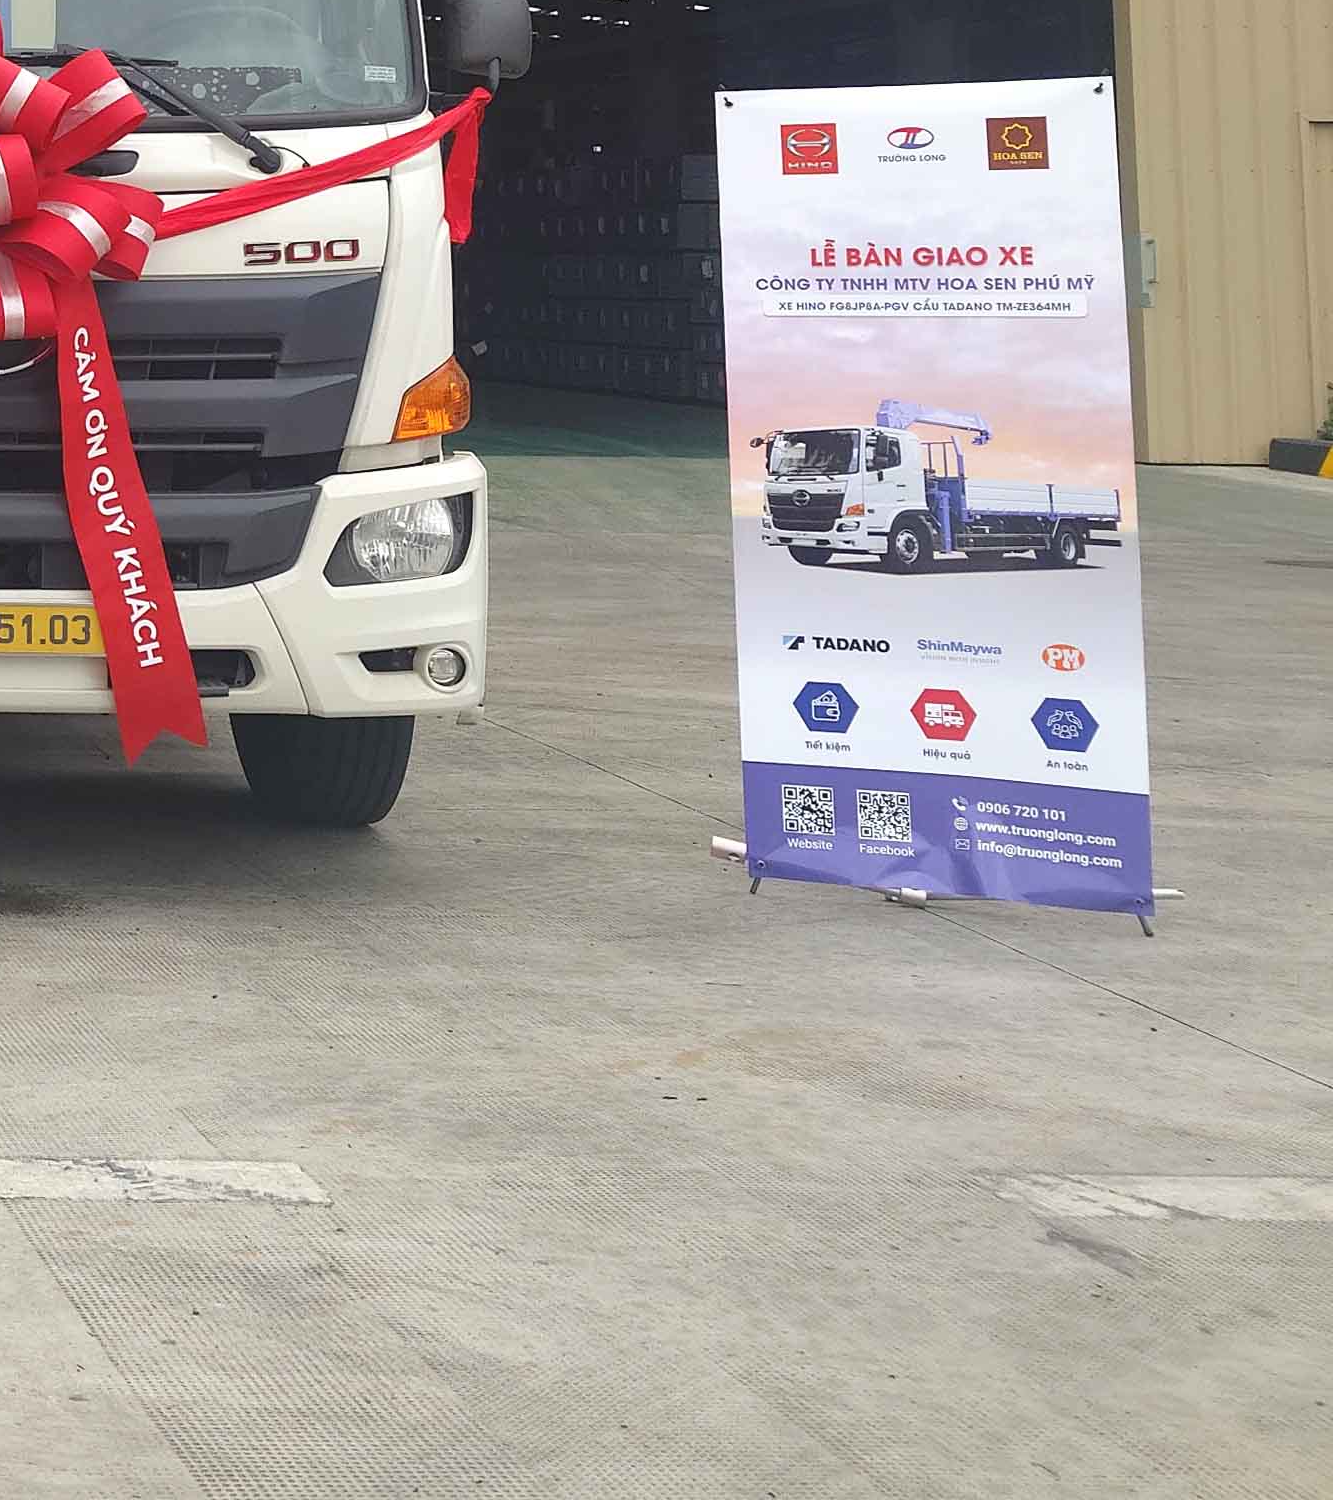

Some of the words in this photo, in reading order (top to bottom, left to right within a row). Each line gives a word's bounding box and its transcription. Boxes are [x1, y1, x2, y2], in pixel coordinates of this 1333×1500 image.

[919, 154, 947, 162] LONG
[993, 152, 1018, 160] HOA
[244, 238, 360, 267] 500
[810, 238, 837, 267] LỄ
[846, 242, 903, 267] BÀN
[913, 246, 989, 267] GIAO
[998, 246, 1035, 267] XE
[755, 275, 811, 291] CÔNG
[815, 278, 836, 291] TY
[840, 278, 888, 291] TNHH
[894, 277, 932, 291] MTV
[936, 277, 978, 291] HOA
[983, 277, 1017, 291] SEN
[1023, 273, 1061, 291] PHÚ
[1067, 273, 1095, 291] MỸ
[779, 301, 793, 311] XE
[796, 301, 826, 311] HINO
[943, 301, 993, 312] TADANO
[996, 301, 1071, 312] TM-ZE364MH
[73, 326, 100, 403] CẢM
[85, 408, 109, 459] ƠN
[89, 465, 137, 536] QUÝ
[113, 547, 165, 669] KHÁCH
[812, 636, 891, 653] TADANO
[916, 638, 1003, 656] ShinMaywa
[976, 801, 1011, 815] 0906
[1013, 804, 1039, 819] 720
[1042, 808, 1067, 822] 101
[787, 836, 834, 851] Website
[975, 821, 1117, 847] www.truonglong.com
[859, 842, 916, 859] Facebook
[977, 839, 1123, 869] info@truonglong.com
